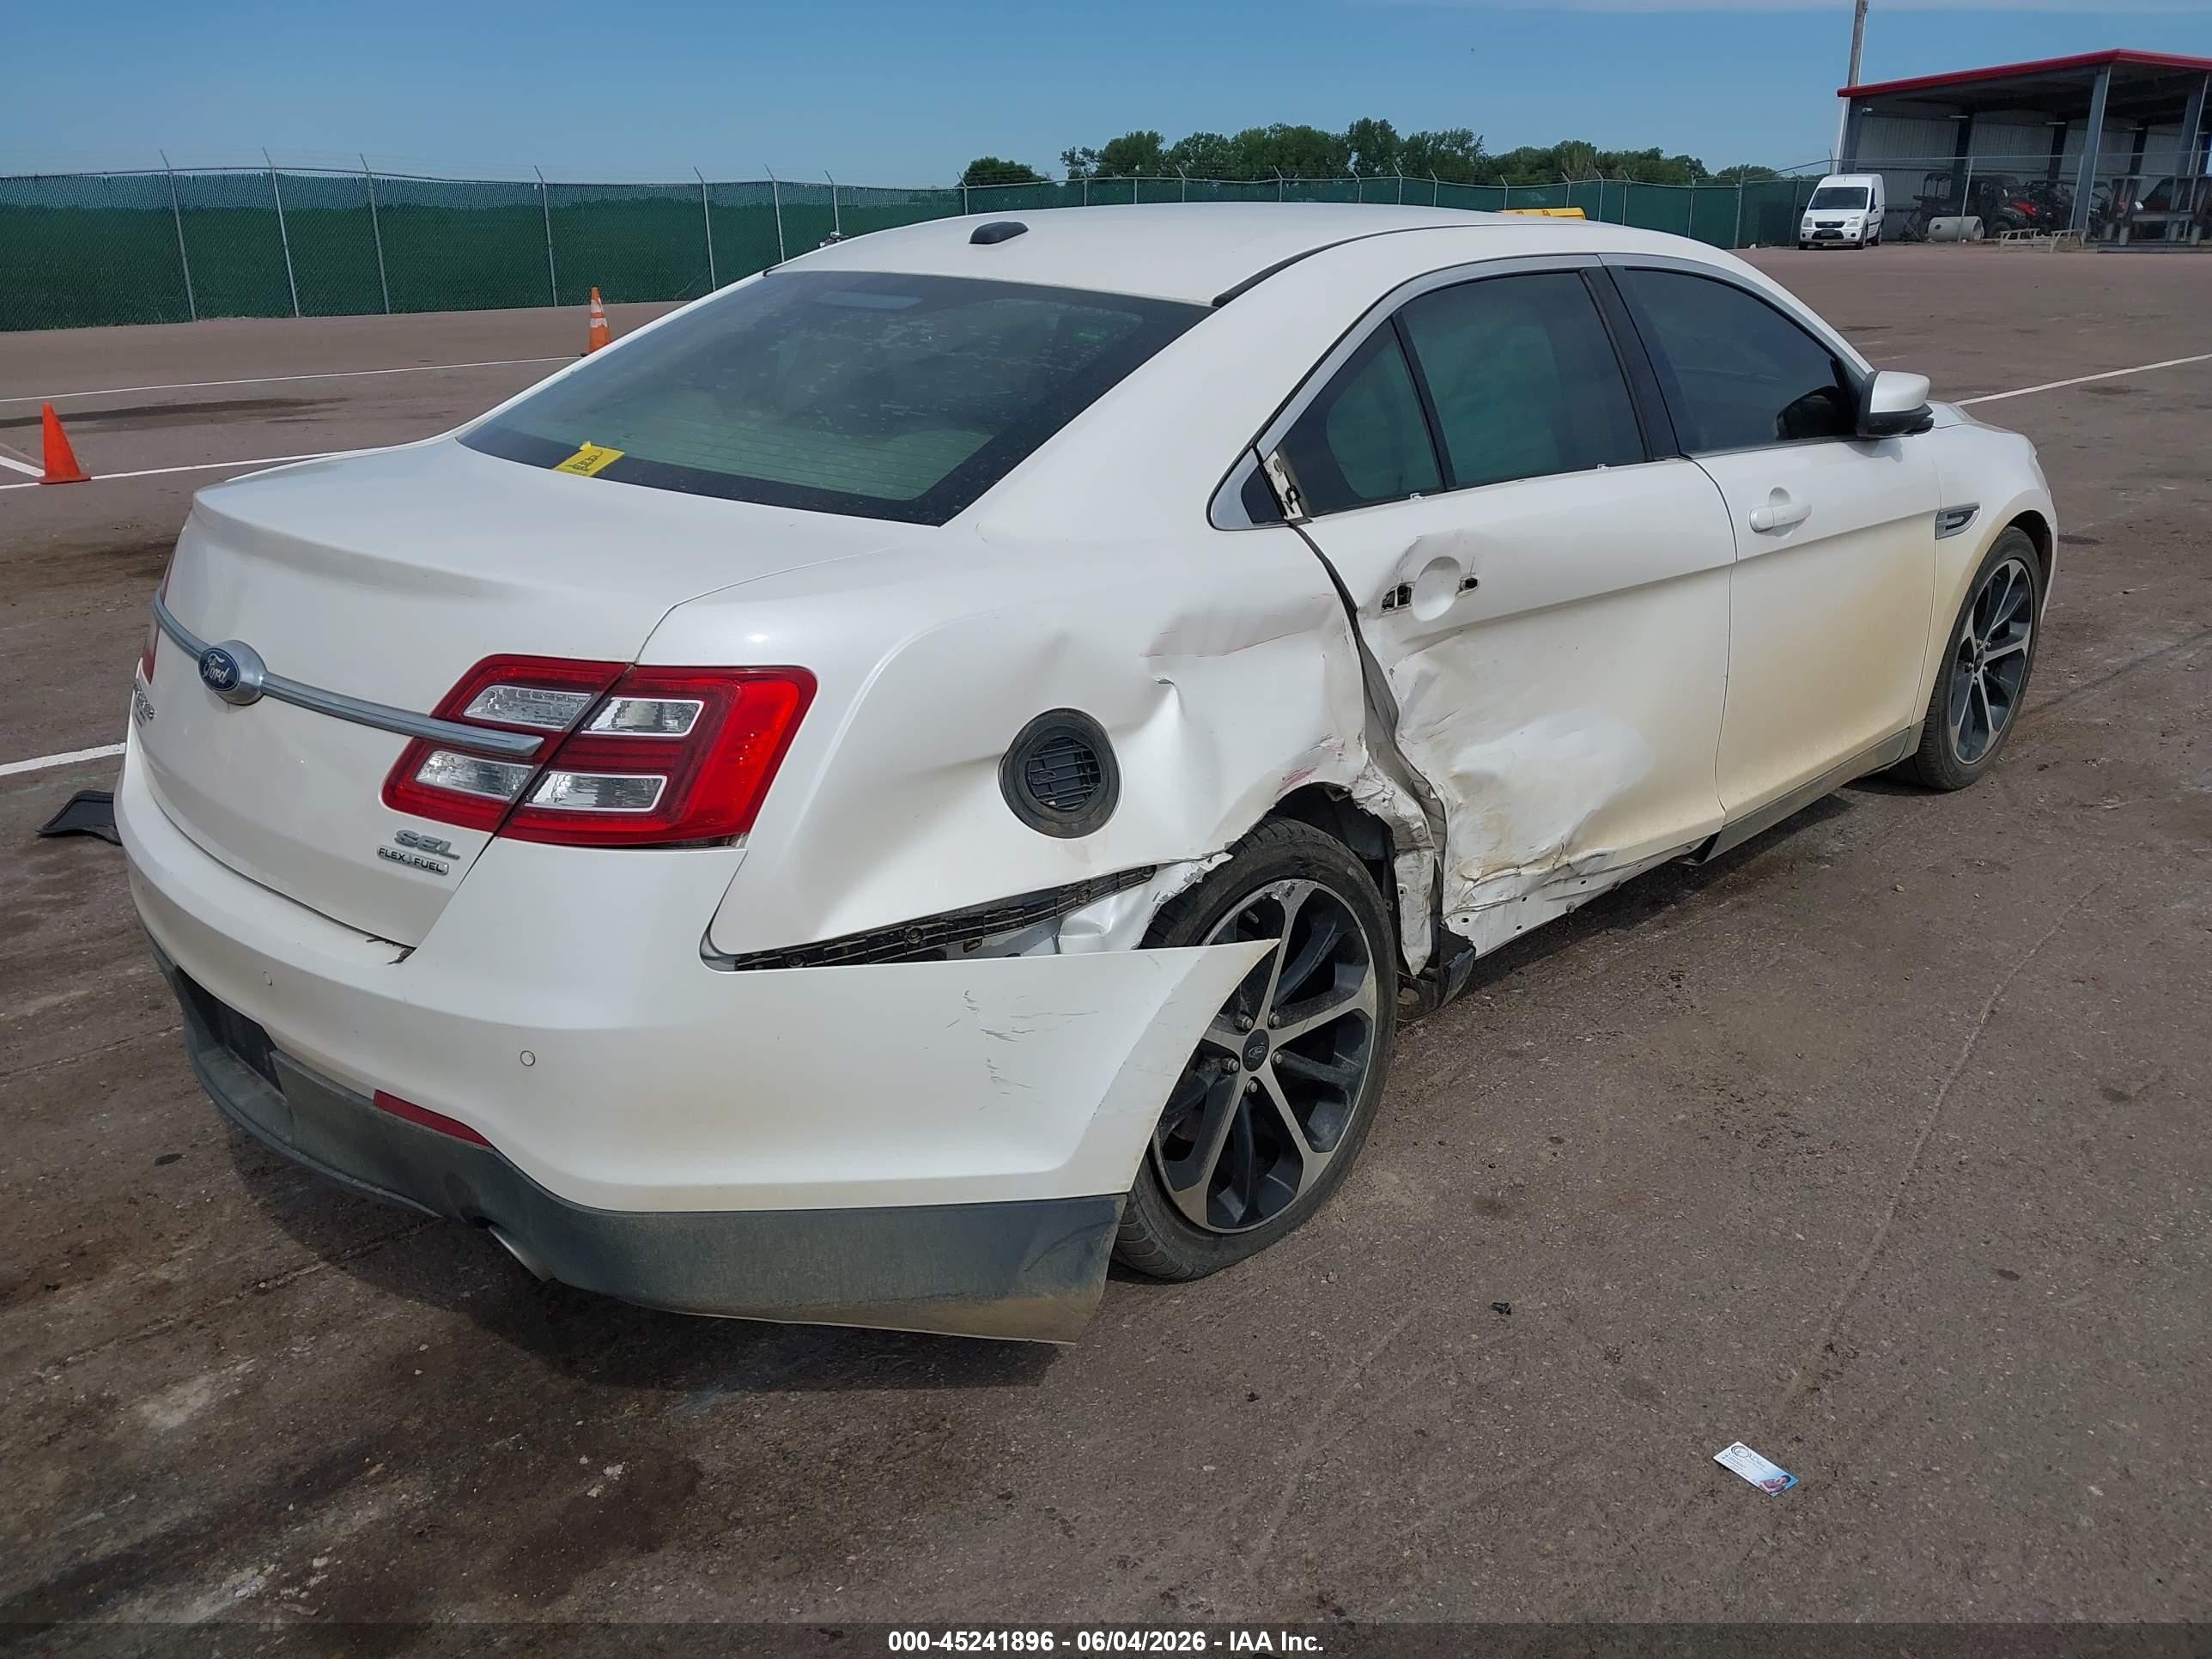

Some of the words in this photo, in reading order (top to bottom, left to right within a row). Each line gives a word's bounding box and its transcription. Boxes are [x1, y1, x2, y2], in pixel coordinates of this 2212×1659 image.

[203, 653, 230, 684] Ford
[379, 847, 406, 862] FLEX
[414, 857, 444, 873] FUEL
[394, 830, 461, 860] SEL
